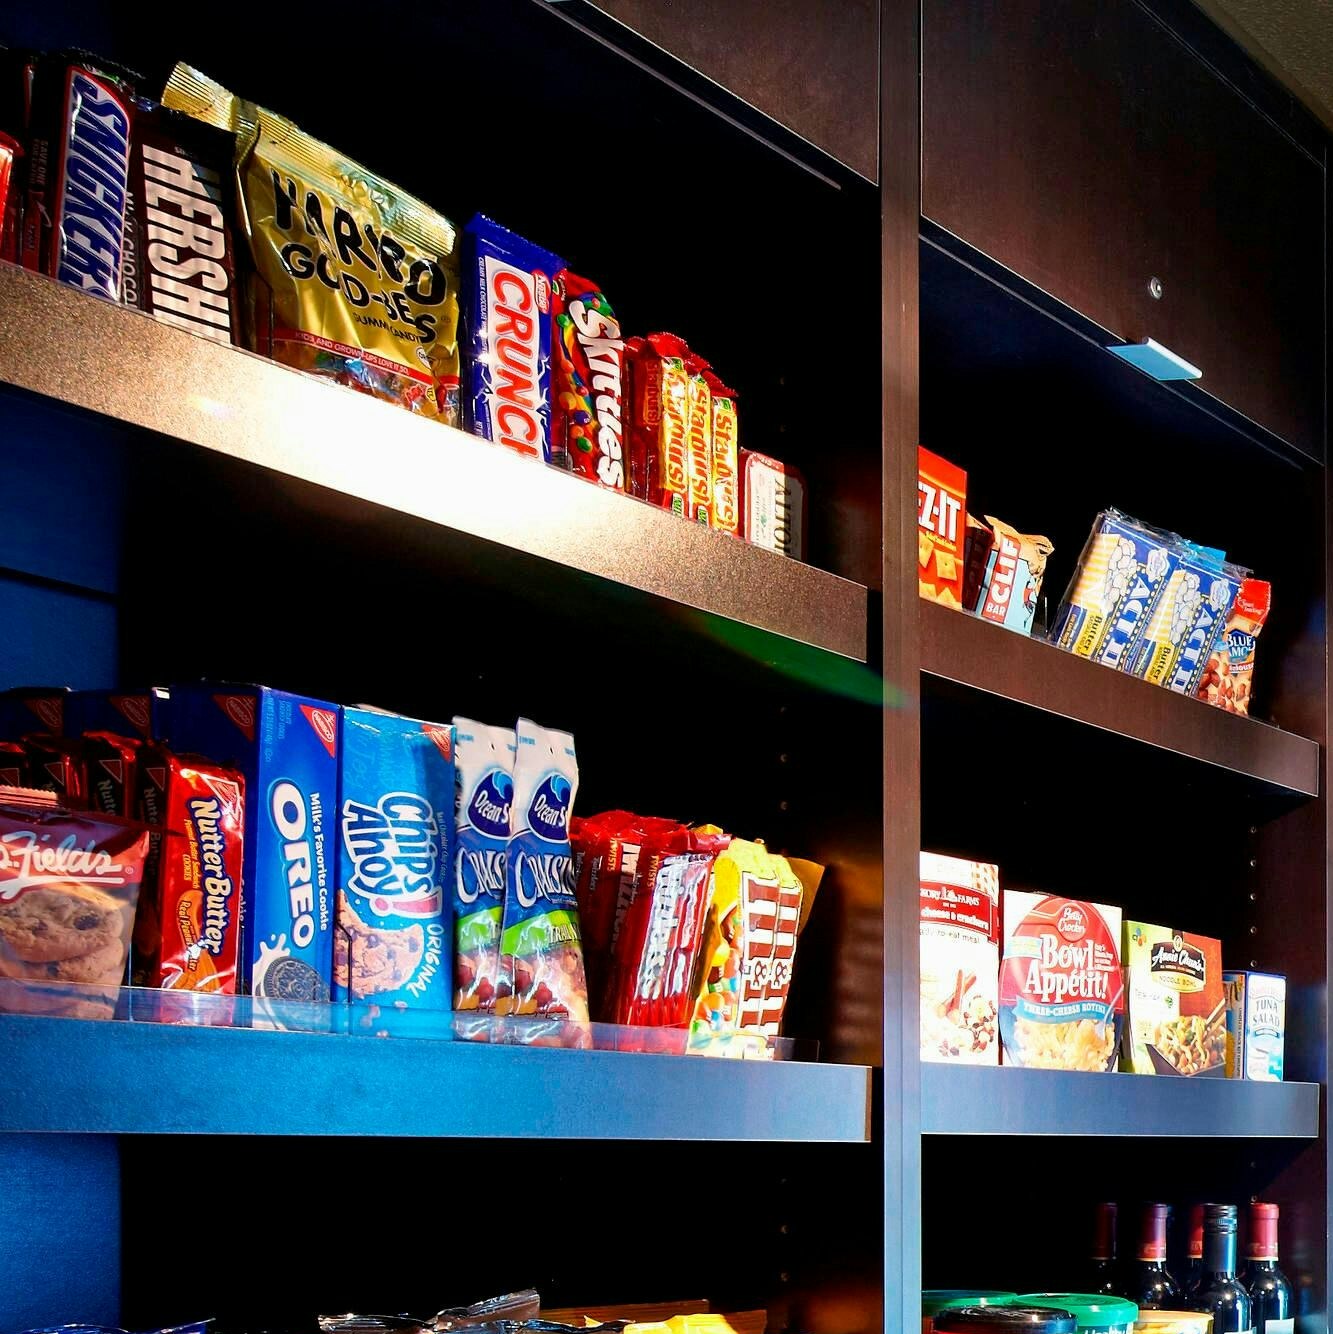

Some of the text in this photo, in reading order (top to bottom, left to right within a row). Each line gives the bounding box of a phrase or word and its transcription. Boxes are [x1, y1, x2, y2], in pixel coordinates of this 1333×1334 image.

[315, 337, 333, 350] AND
[334, 342, 378, 365] GROWN-UPS
[991, 538, 1019, 603] CLIF
[986, 604, 1007, 617] BAR
[1085, 614, 1102, 653] Butter
[1227, 631, 1253, 648] BLUE
[1153, 645, 1170, 680] Butter
[313, 710, 334, 742] NABISCO
[475, 791, 501, 822] Ocean
[534, 795, 560, 827] Ocean
[3, 829, 122, 878] Fields
[188, 842, 198, 860] Butter
[379, 793, 437, 896] Chips
[183, 854, 192, 881] COOKIES
[191, 800, 231, 954] Nutter Butter
[272, 781, 316, 948] OREO
[309, 793, 329, 931] Milk's Favorite Cookie
[179, 902, 192, 918] Real
[959, 895, 980, 907] FARMS
[1063, 907, 1082, 921] Betty
[1058, 919, 1086, 933] Crocker
[406, 923, 446, 999] ORIGINAL
[1040, 934, 1095, 970] Bowl
[1152, 947, 1177, 966] Annie
[1024, 959, 1109, 1003] Appétit!
[1253, 1014, 1280, 1027] SALAD
[1254, 999, 1278, 1012] TUNA
